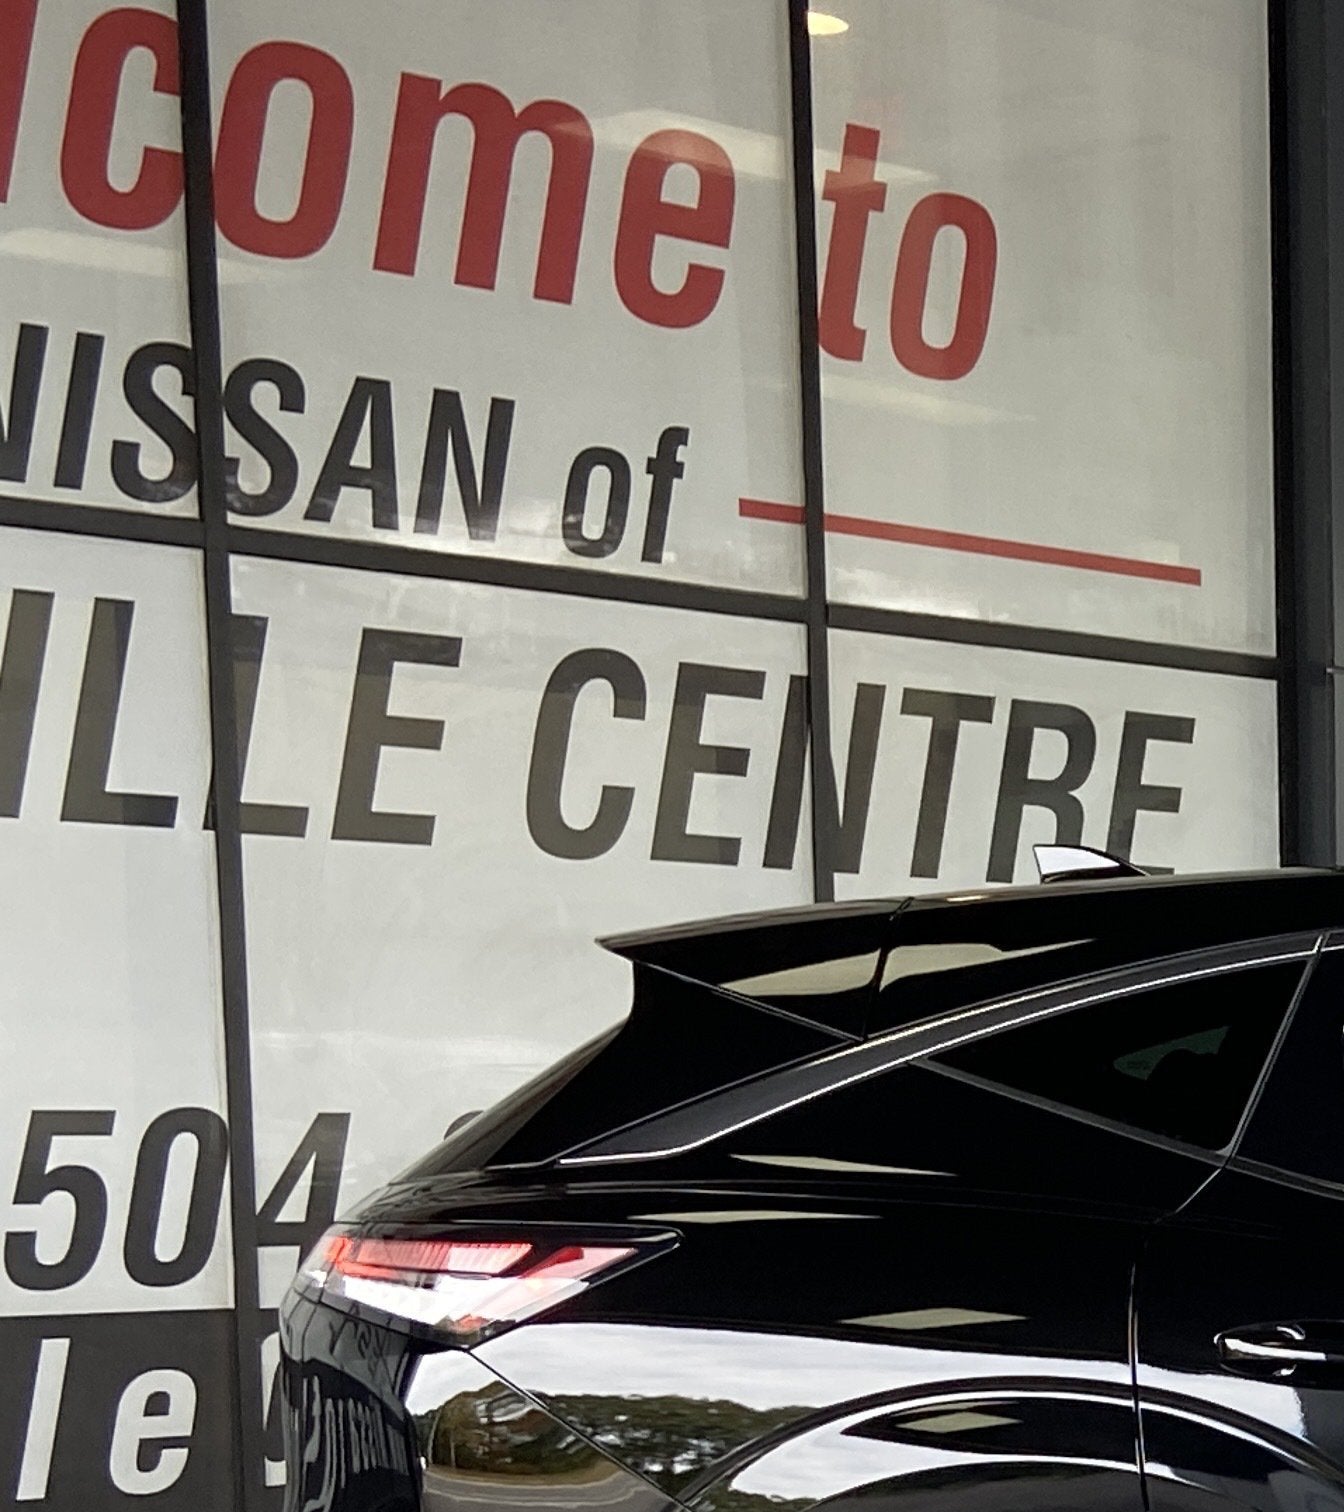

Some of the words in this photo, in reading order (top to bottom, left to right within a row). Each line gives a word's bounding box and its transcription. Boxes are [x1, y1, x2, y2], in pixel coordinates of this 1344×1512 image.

[818, 122, 999, 382] to
[561, 426, 689, 564] of
[524, 648, 1196, 884] CENTRE
